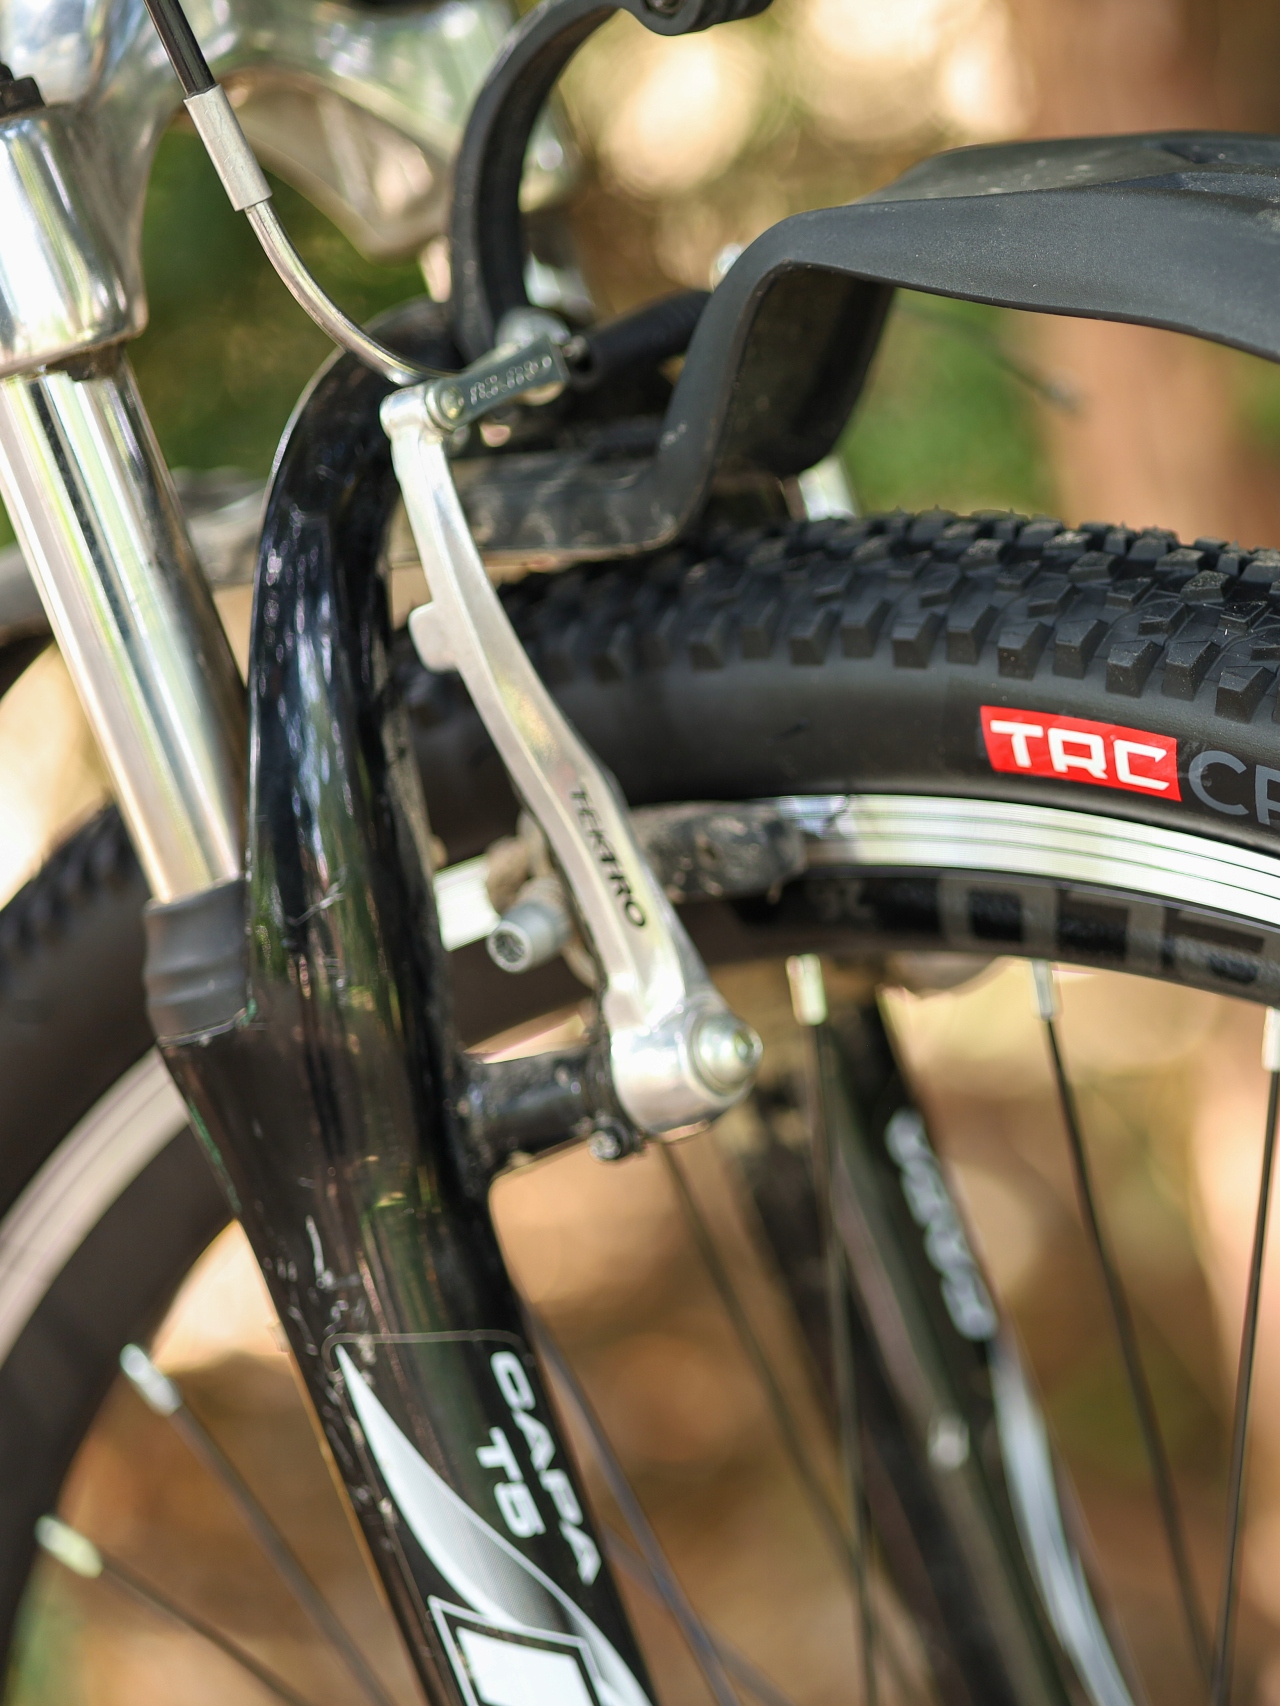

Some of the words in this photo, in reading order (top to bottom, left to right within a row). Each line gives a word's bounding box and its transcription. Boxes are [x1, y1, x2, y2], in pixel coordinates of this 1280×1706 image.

[989, 719, 1170, 791] TRC
[570, 784, 647, 927] TEKTRO
[475, 1426, 546, 1538] T5
[490, 1350, 602, 1586] CAPA
